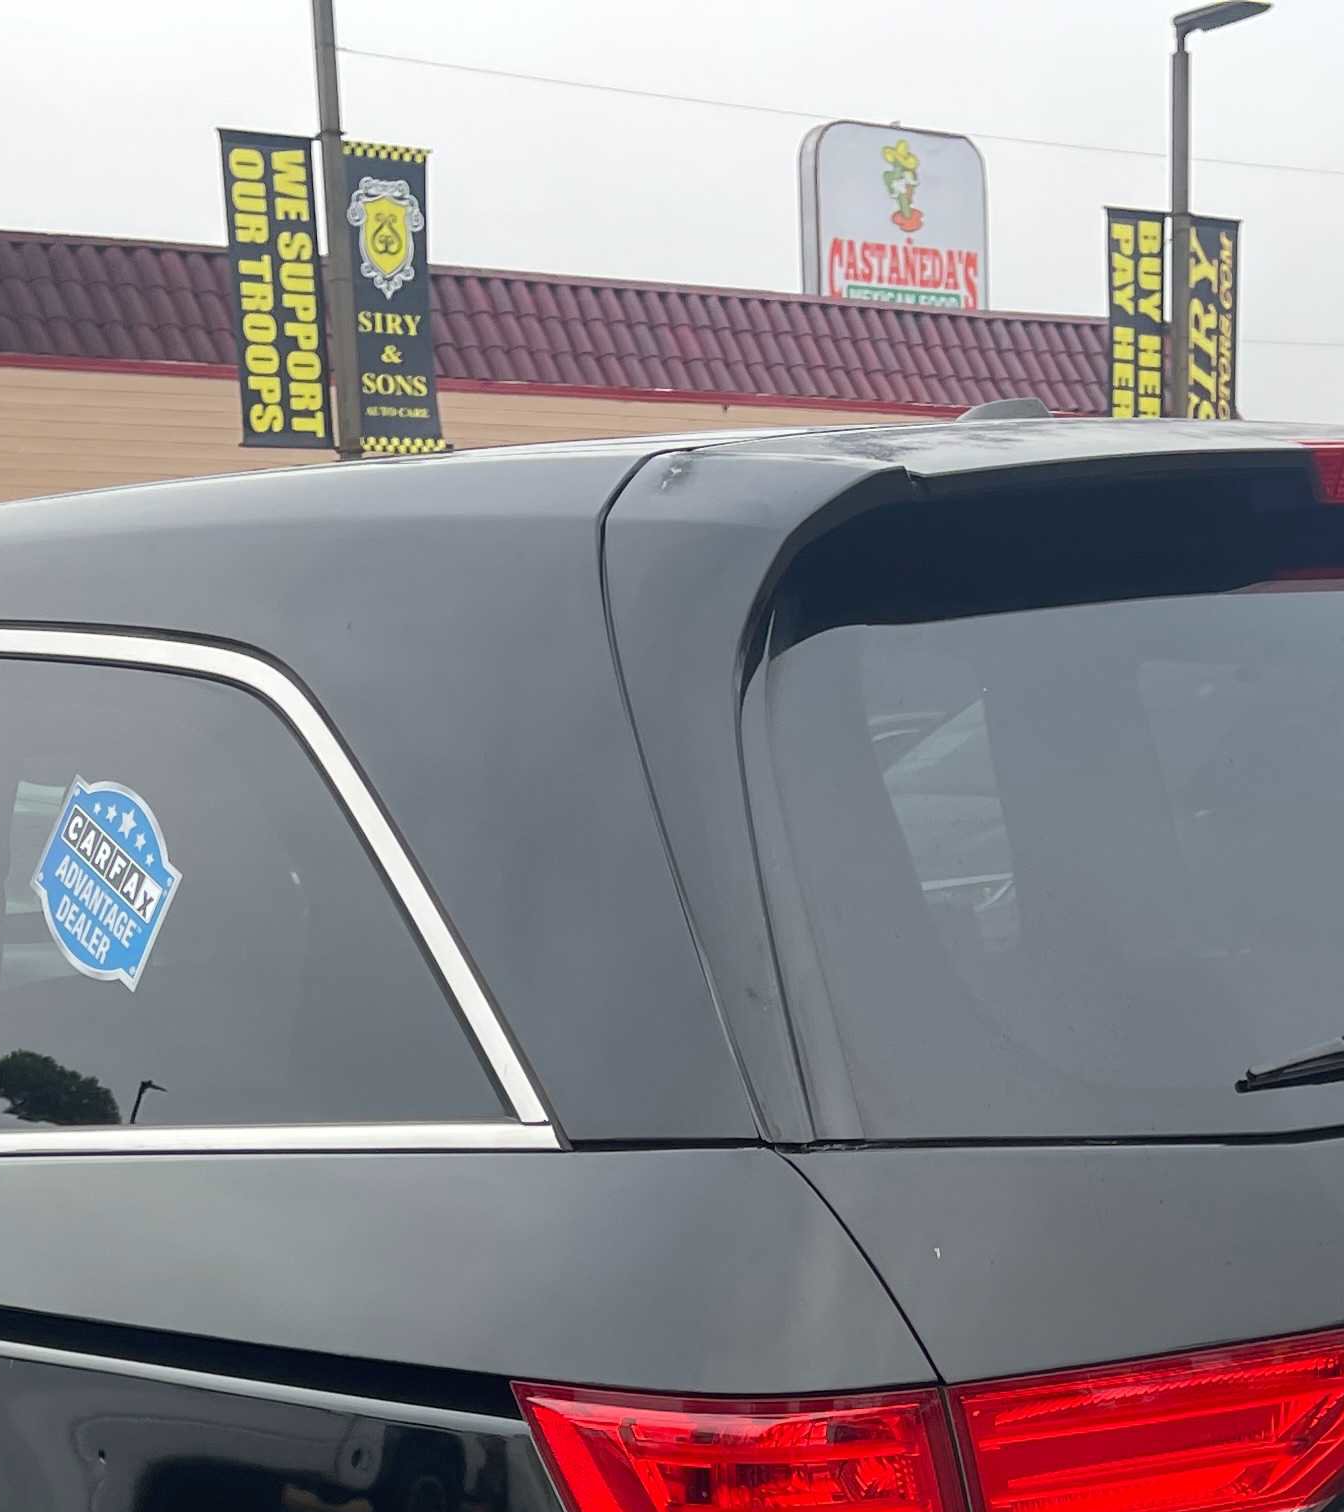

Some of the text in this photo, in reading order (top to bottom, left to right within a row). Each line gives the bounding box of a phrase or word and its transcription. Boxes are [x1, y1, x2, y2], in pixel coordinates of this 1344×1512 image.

[228, 147, 285, 433] OUR TROOPS
[271, 149, 326, 439] WE SUPPORT
[358, 310, 421, 337] SIRY
[1110, 222, 1136, 419] PAY HER
[1136, 220, 1163, 418] BUY HER
[1217, 231, 1233, 420] OTORS.COM
[362, 372, 428, 397] SONS
[381, 344, 403, 364] &
[54, 854, 137, 949] ADVANTAGE
[66, 812, 158, 923] CARFAX
[55, 894, 111, 965] DEALER
